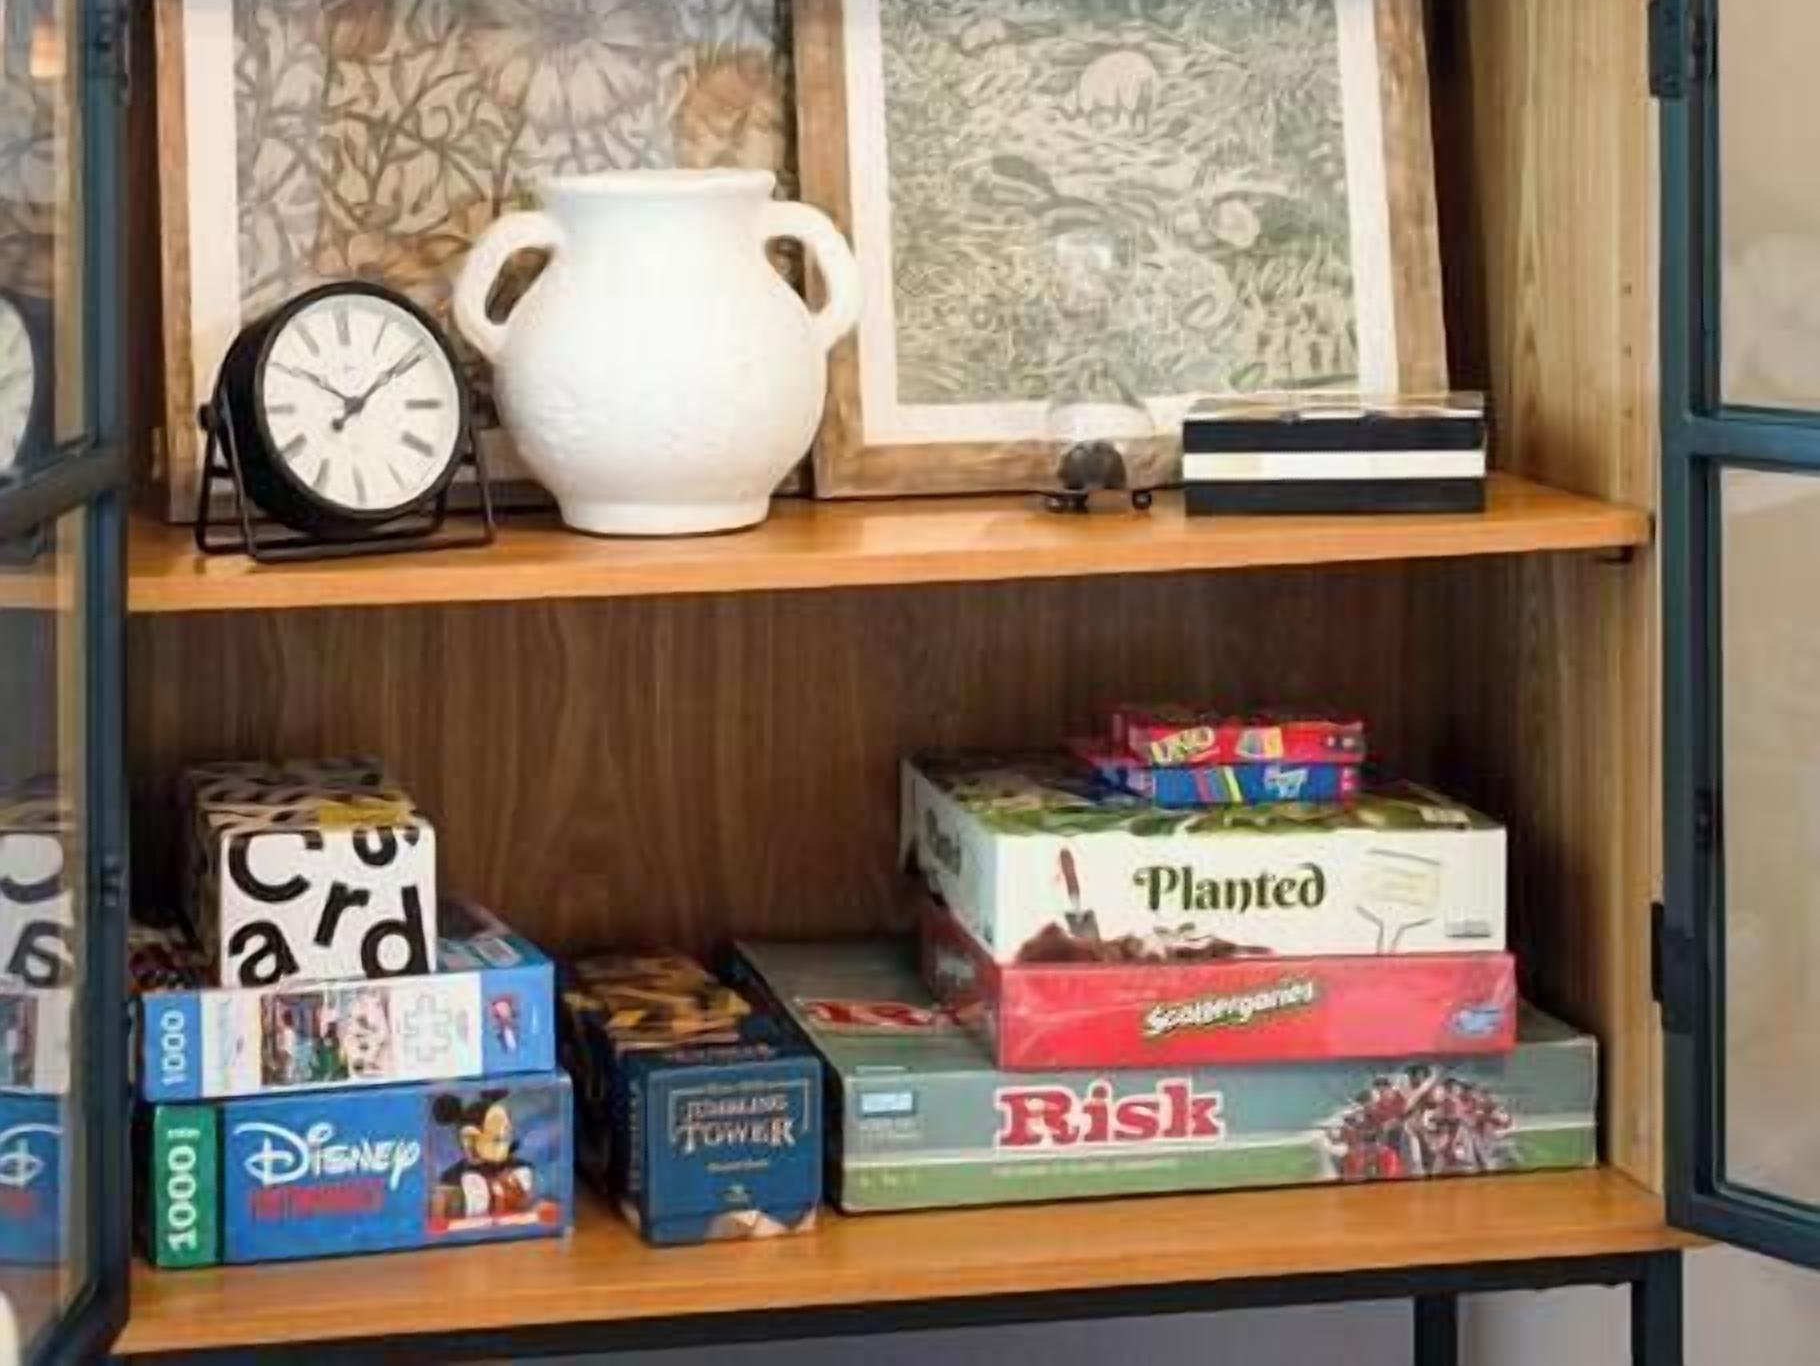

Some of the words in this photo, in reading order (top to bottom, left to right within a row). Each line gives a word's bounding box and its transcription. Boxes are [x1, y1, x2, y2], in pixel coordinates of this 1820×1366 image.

[1132, 862, 1326, 915] Planted
[160, 1010, 187, 1085] 1000
[996, 1078, 1224, 1148] Risk
[232, 1122, 422, 1191] Disney
